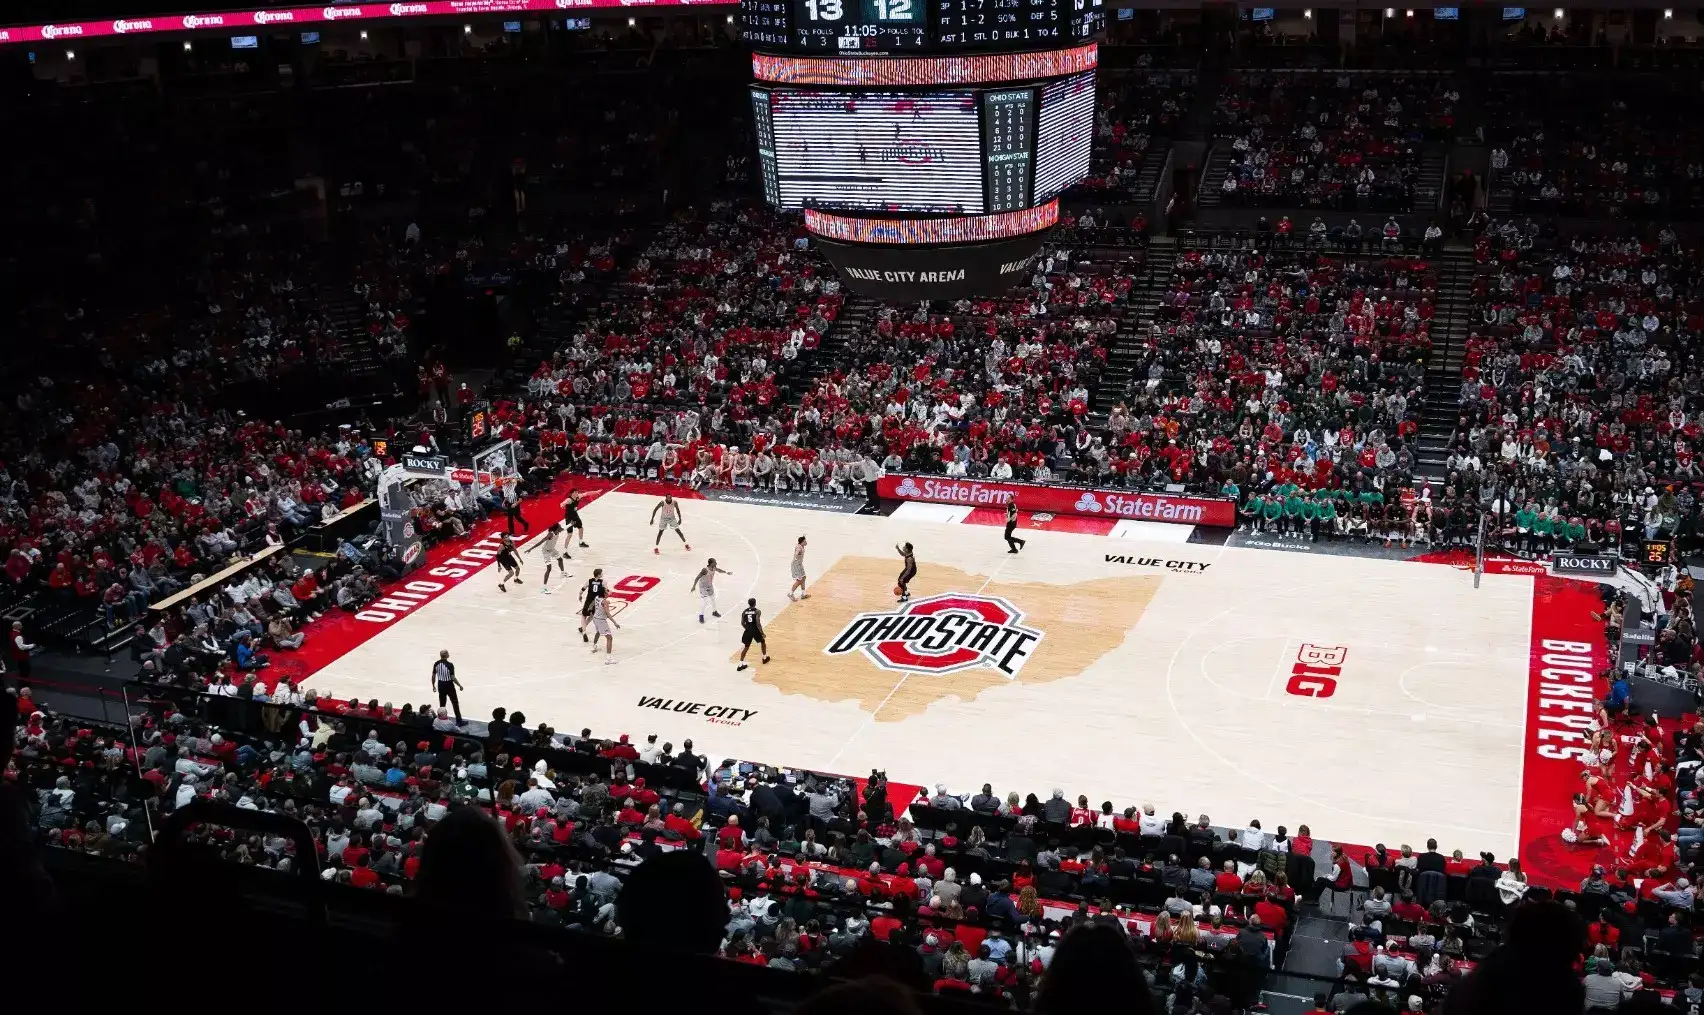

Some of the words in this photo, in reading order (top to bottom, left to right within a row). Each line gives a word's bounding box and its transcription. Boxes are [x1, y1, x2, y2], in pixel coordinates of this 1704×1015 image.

[324, 7, 361, 20] Corona
[390, 3, 427, 16] Corona
[805, 0, 843, 20] 13
[874, 0, 912, 19] 12
[1051, 10, 1057, 20] 5
[183, 15, 223, 28] Corona
[254, 11, 293, 25] Corona
[41, 25, 82, 39] Corona
[113, 19, 152, 33] Corona
[845, 25, 877, 36] 11:05
[896, 37, 901, 45] 1
[915, 36, 921, 45] 4
[941, 34, 956, 42] AST
[961, 32, 966, 42] 1
[992, 30, 998, 40] 0
[1024, 29, 1029, 38] 1
[1052, 27, 1058, 36] 4
[801, 37, 806, 46] 4
[820, 37, 826, 46] 3
[1000, 259, 1025, 275] VALUE
[846, 267, 882, 281] VALUE
[884, 270, 914, 282] CITY
[920, 269, 965, 282] ARENA
[407, 458, 440, 470] ROCKY
[1245, 540, 1310, 550] #GoBucks
[1105, 555, 1163, 566] VALUE
[1166, 560, 1211, 571] CITY
[1649, 552, 1662, 562] 25
[1560, 558, 1611, 570] ROCKY
[355, 580, 445, 622] OHIO
[1623, 632, 1654, 640] Safelite
[1537, 640, 1593, 762] BUCKEYES
[638, 696, 706, 714] VALUE
[704, 706, 758, 721] CITY
[707, 718, 741, 726] Arena
